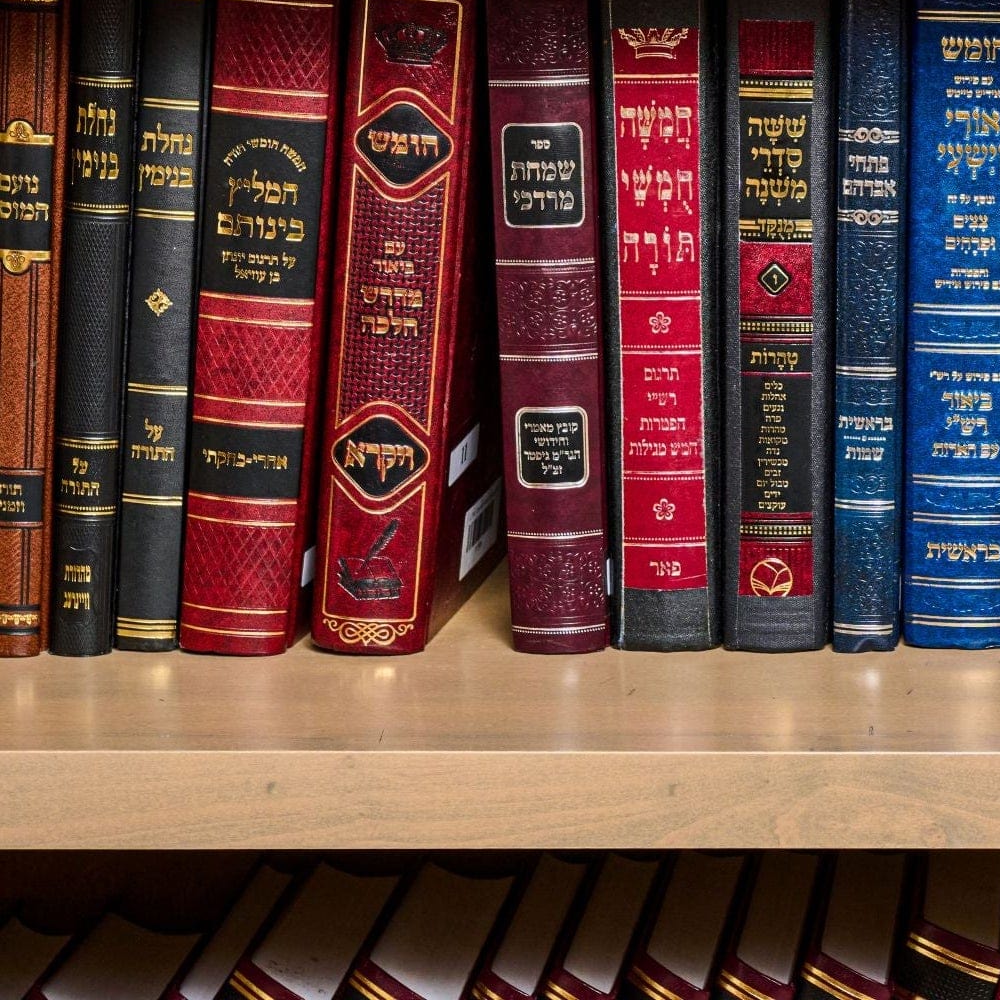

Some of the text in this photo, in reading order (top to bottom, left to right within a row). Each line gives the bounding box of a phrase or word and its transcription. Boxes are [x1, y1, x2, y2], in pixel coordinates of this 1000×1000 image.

[141, 122, 193, 155] נחלת
[368, 129, 439, 158] חומש
[511, 159, 575, 181] שמחת
[842, 178, 897, 198] אברהם
[513, 189, 575, 211] מרדכי
[360, 284, 423, 308] מדרש
[838, 414, 894, 432] בראשית
[344, 439, 414, 483] ויקרא
[649, 560, 682, 577] פאר
